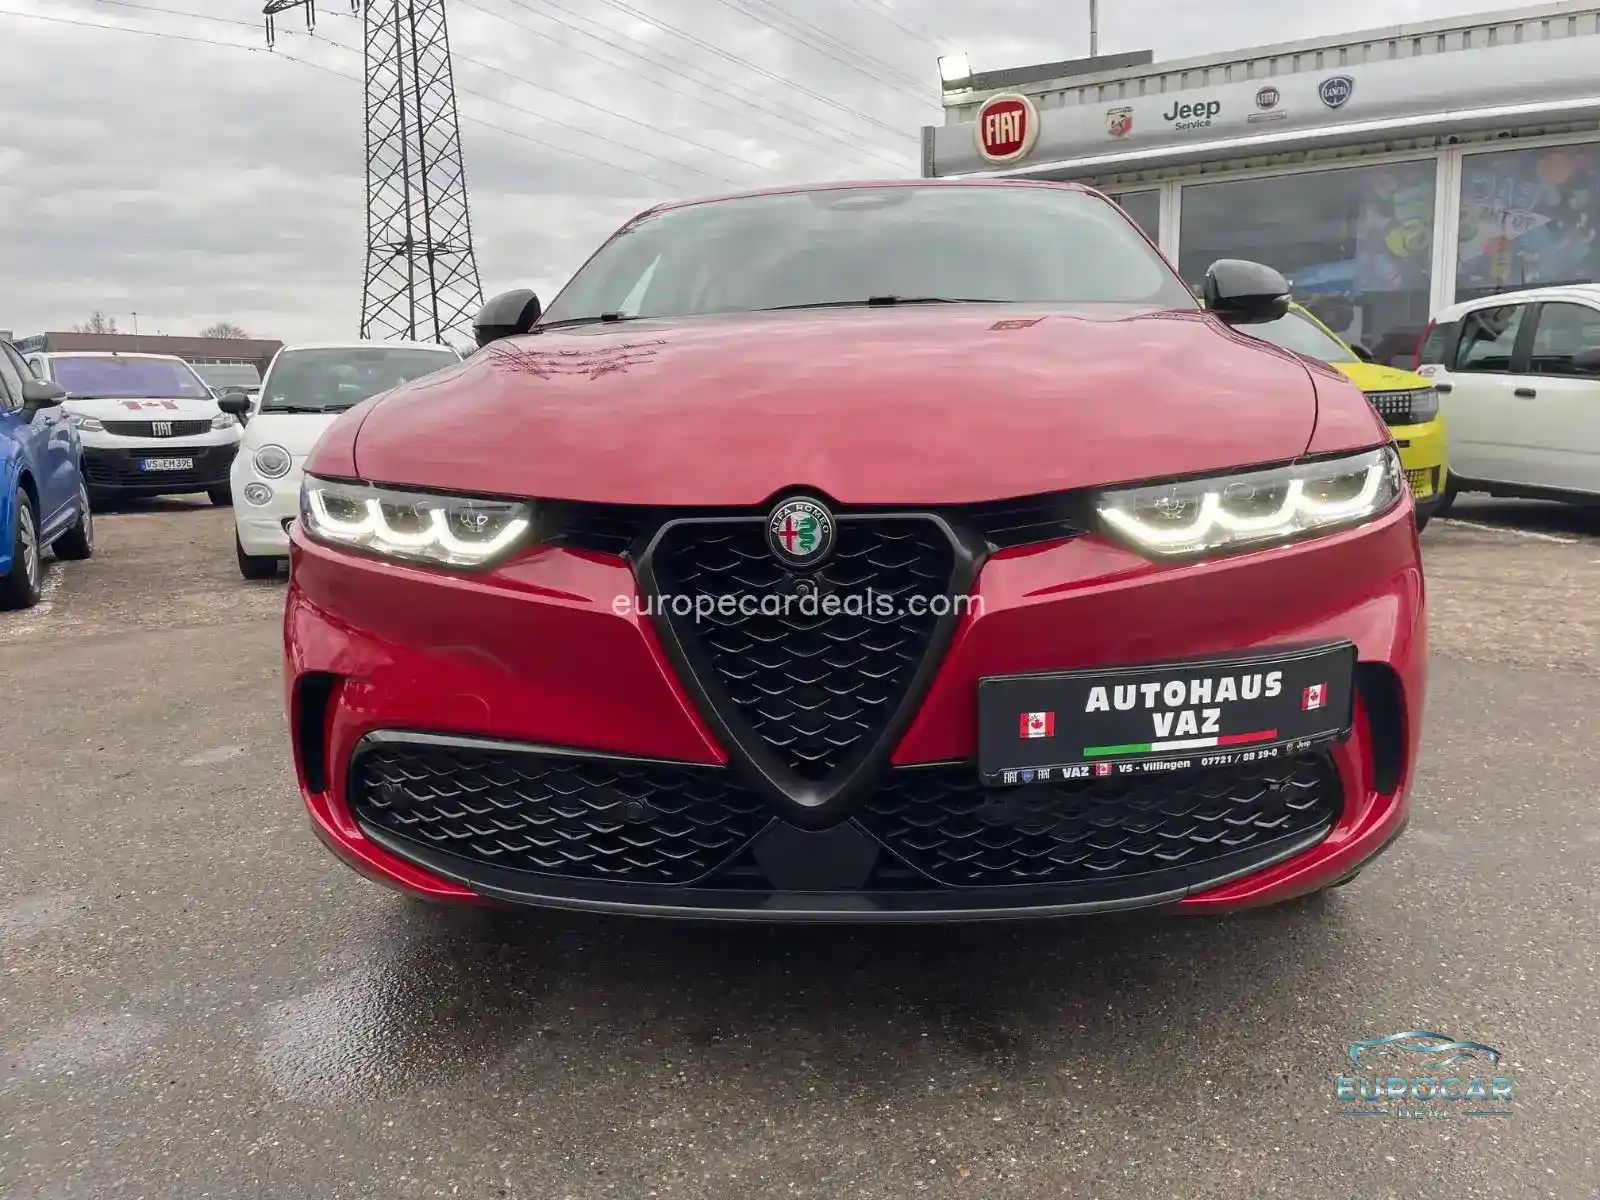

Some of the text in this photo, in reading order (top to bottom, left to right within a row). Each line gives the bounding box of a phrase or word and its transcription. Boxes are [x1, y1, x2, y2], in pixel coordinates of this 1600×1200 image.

[1163, 99, 1220, 121] Jeep
[1175, 119, 1211, 131] Service
[985, 110, 1024, 146] FIAT
[152, 422, 172, 436] FIAT
[146, 459, 158, 469] VS
[772, 504, 829, 534] ALFA ROMEO
[1084, 671, 1283, 713] AUTOHAUS
[1152, 708, 1220, 738] VAZ
[1003, 771, 1018, 784] FIAT
[1062, 766, 1090, 779] VAZ
[1118, 763, 1133, 773] VS
[1143, 760, 1191, 772] Villingen
[1201, 754, 1232, 767] 07721
[1257, 748, 1278, 760] 39-0
